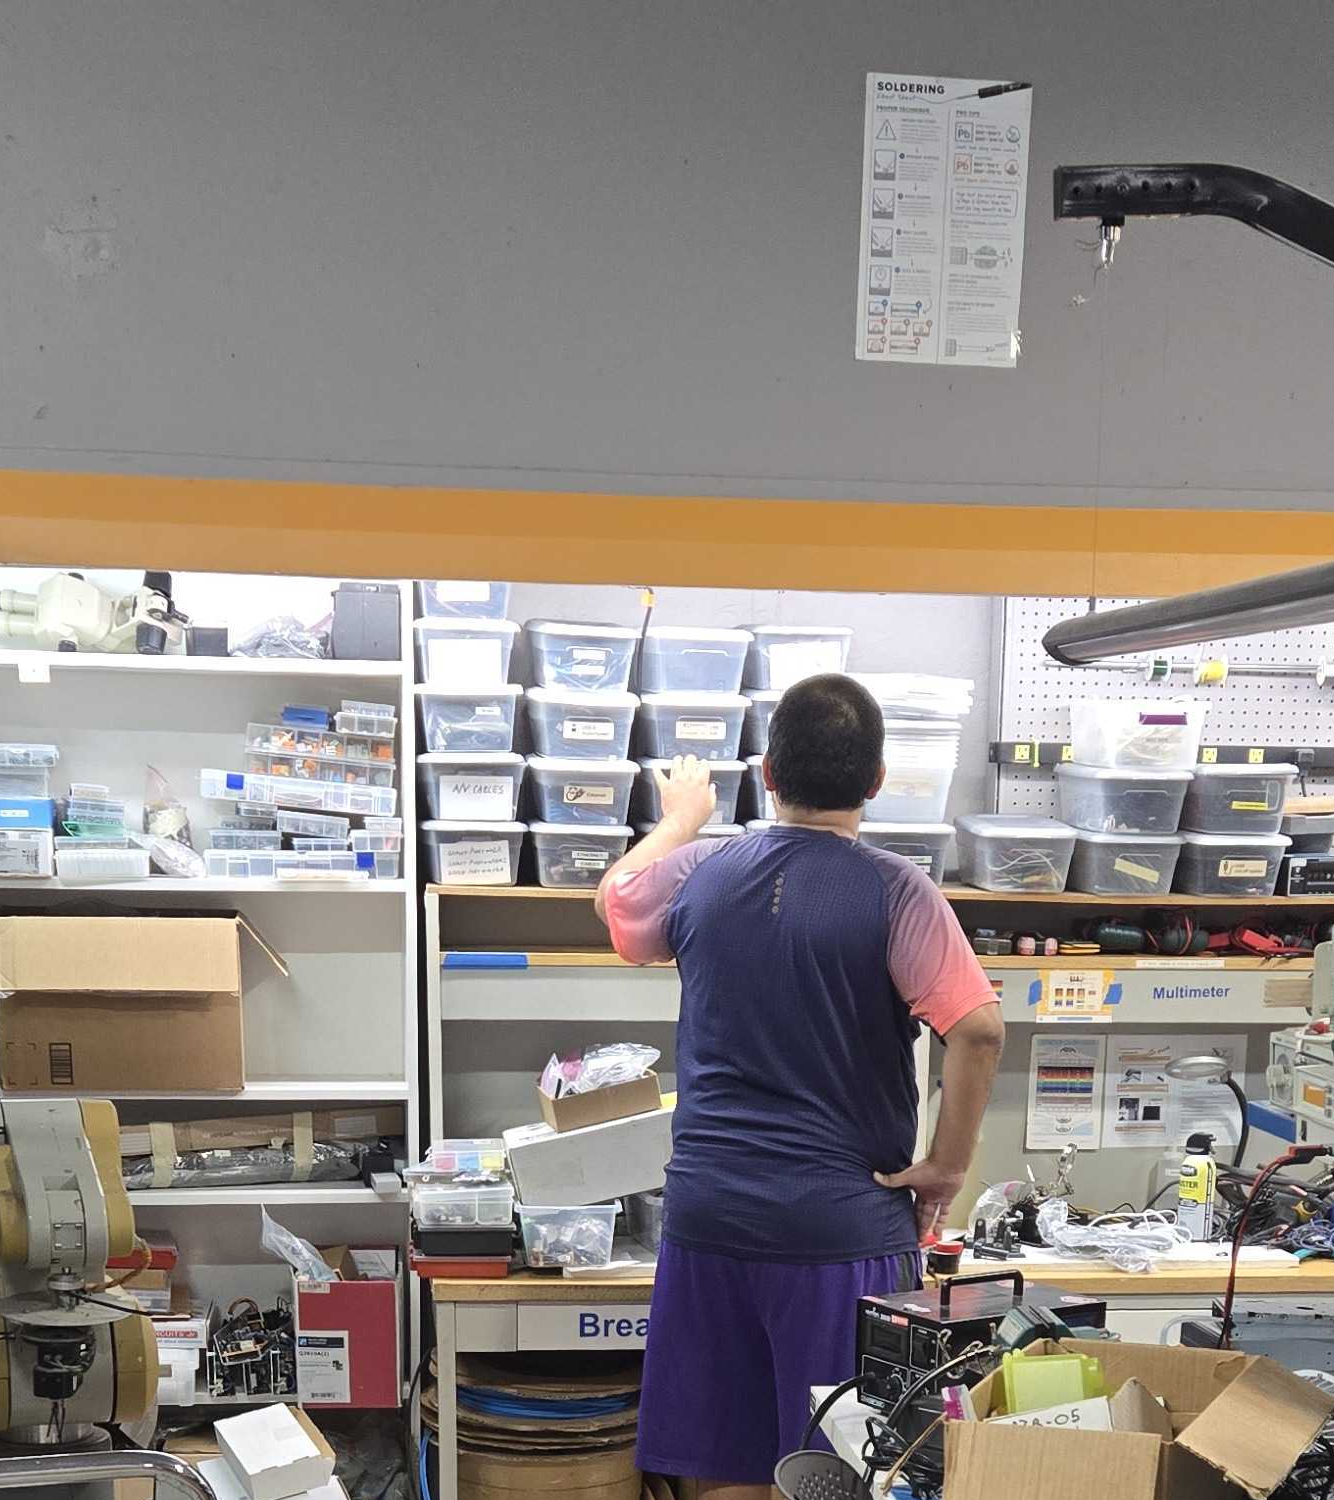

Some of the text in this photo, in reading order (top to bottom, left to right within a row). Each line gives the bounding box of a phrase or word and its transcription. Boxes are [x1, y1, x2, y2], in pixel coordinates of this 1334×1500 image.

[877, 81, 945, 95] SOLDERING
[958, 128, 971, 139] Pb
[956, 159, 969, 171] Pb
[473, 783, 507, 796] CABLES
[1153, 985, 1230, 1000] Multimeter
[579, 1312, 650, 1338] Brea
